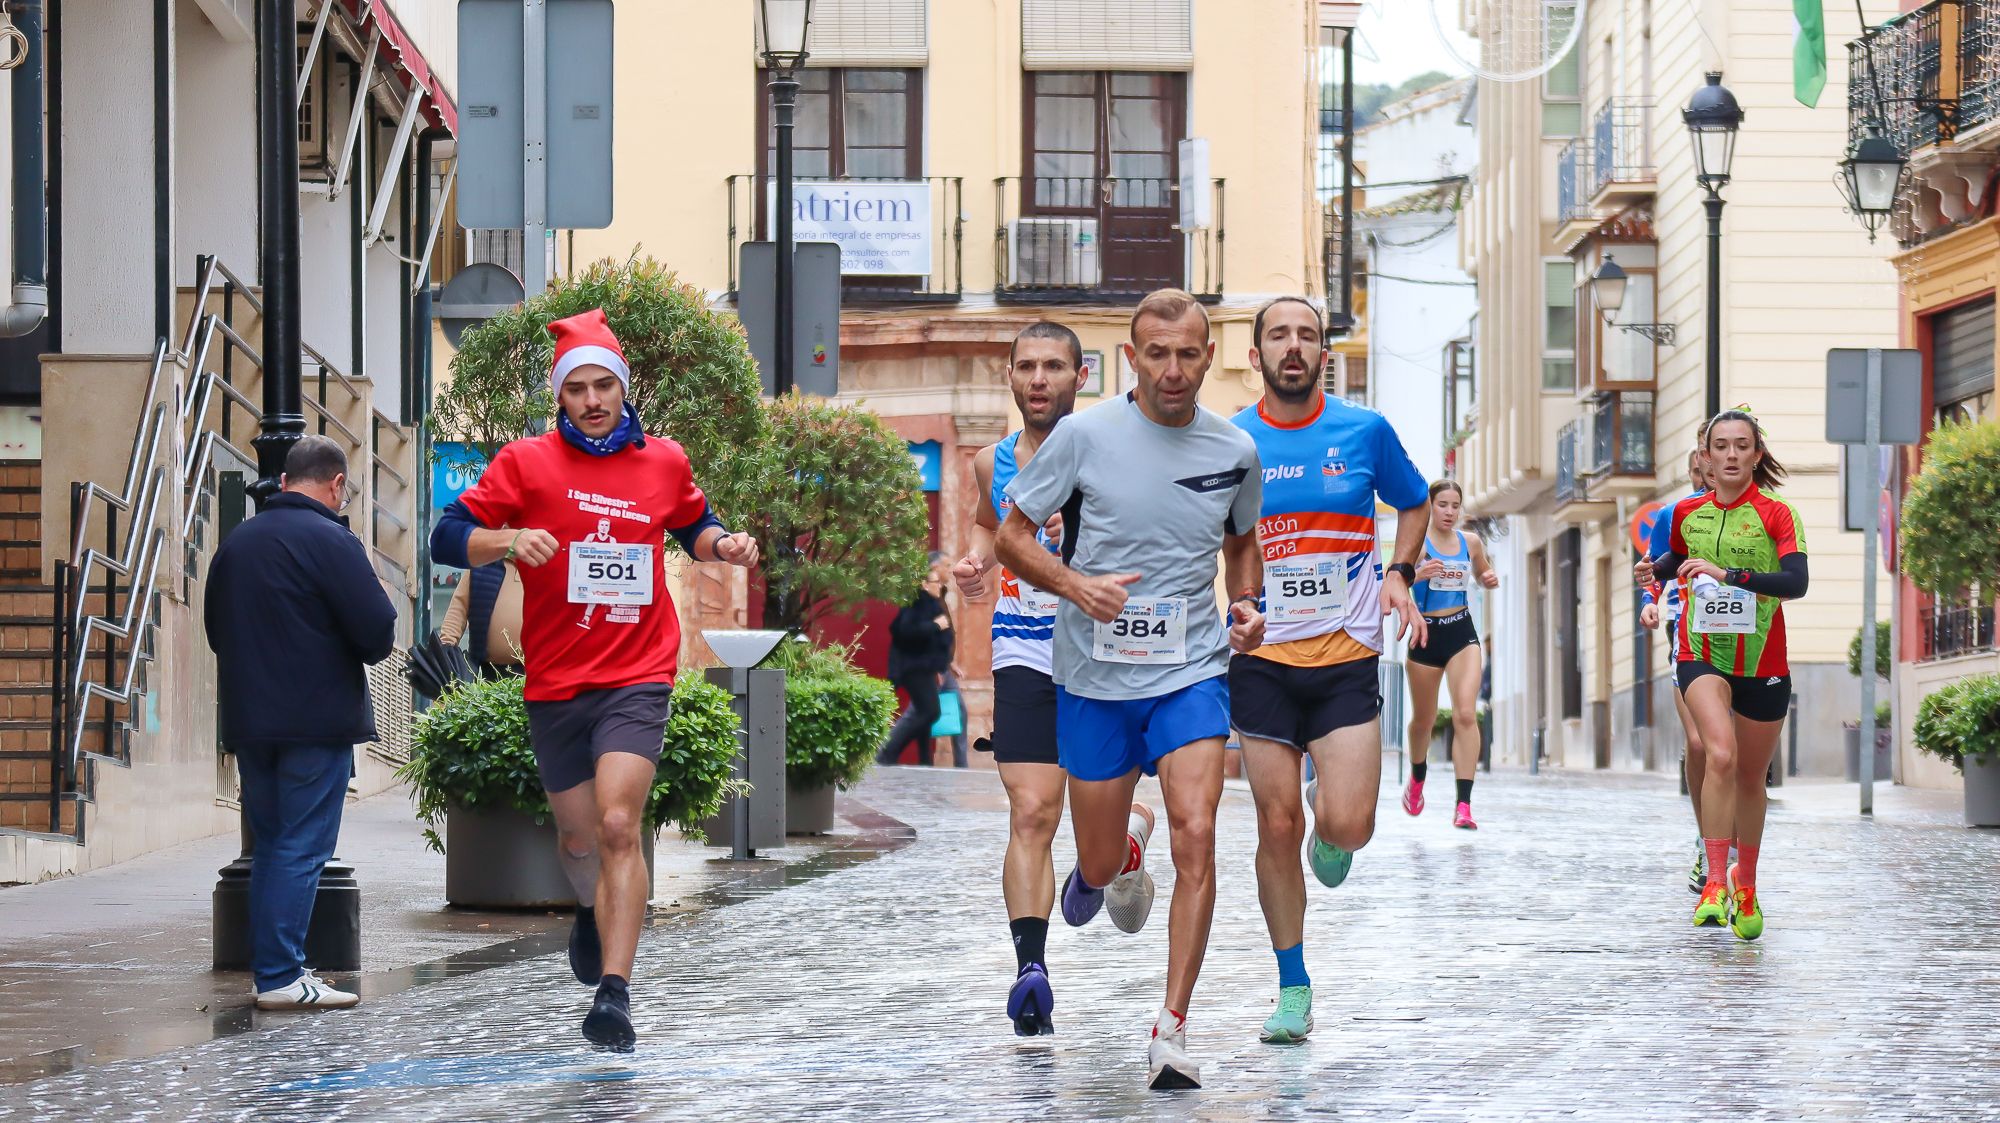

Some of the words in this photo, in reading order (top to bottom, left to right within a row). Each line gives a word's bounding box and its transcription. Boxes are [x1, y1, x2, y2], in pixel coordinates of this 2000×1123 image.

[793, 231, 816, 240] soría
[820, 231, 857, 242] integral
[860, 231, 872, 240] de
[875, 232, 922, 242] empresas
[863, 260, 884, 269] 098
[1261, 464, 1304, 484] rplus
[573, 490, 591, 502] San
[579, 501, 610, 516] Ciudad
[610, 507, 622, 518] de
[621, 509, 651, 524] Lucena
[1258, 516, 1298, 536] atón
[1266, 541, 1297, 559] ena
[587, 562, 638, 581] 501
[1282, 577, 1332, 598] 581
[1704, 601, 1744, 615] 628
[1438, 611, 1464, 625] NIKE
[1112, 618, 1167, 637] 384
